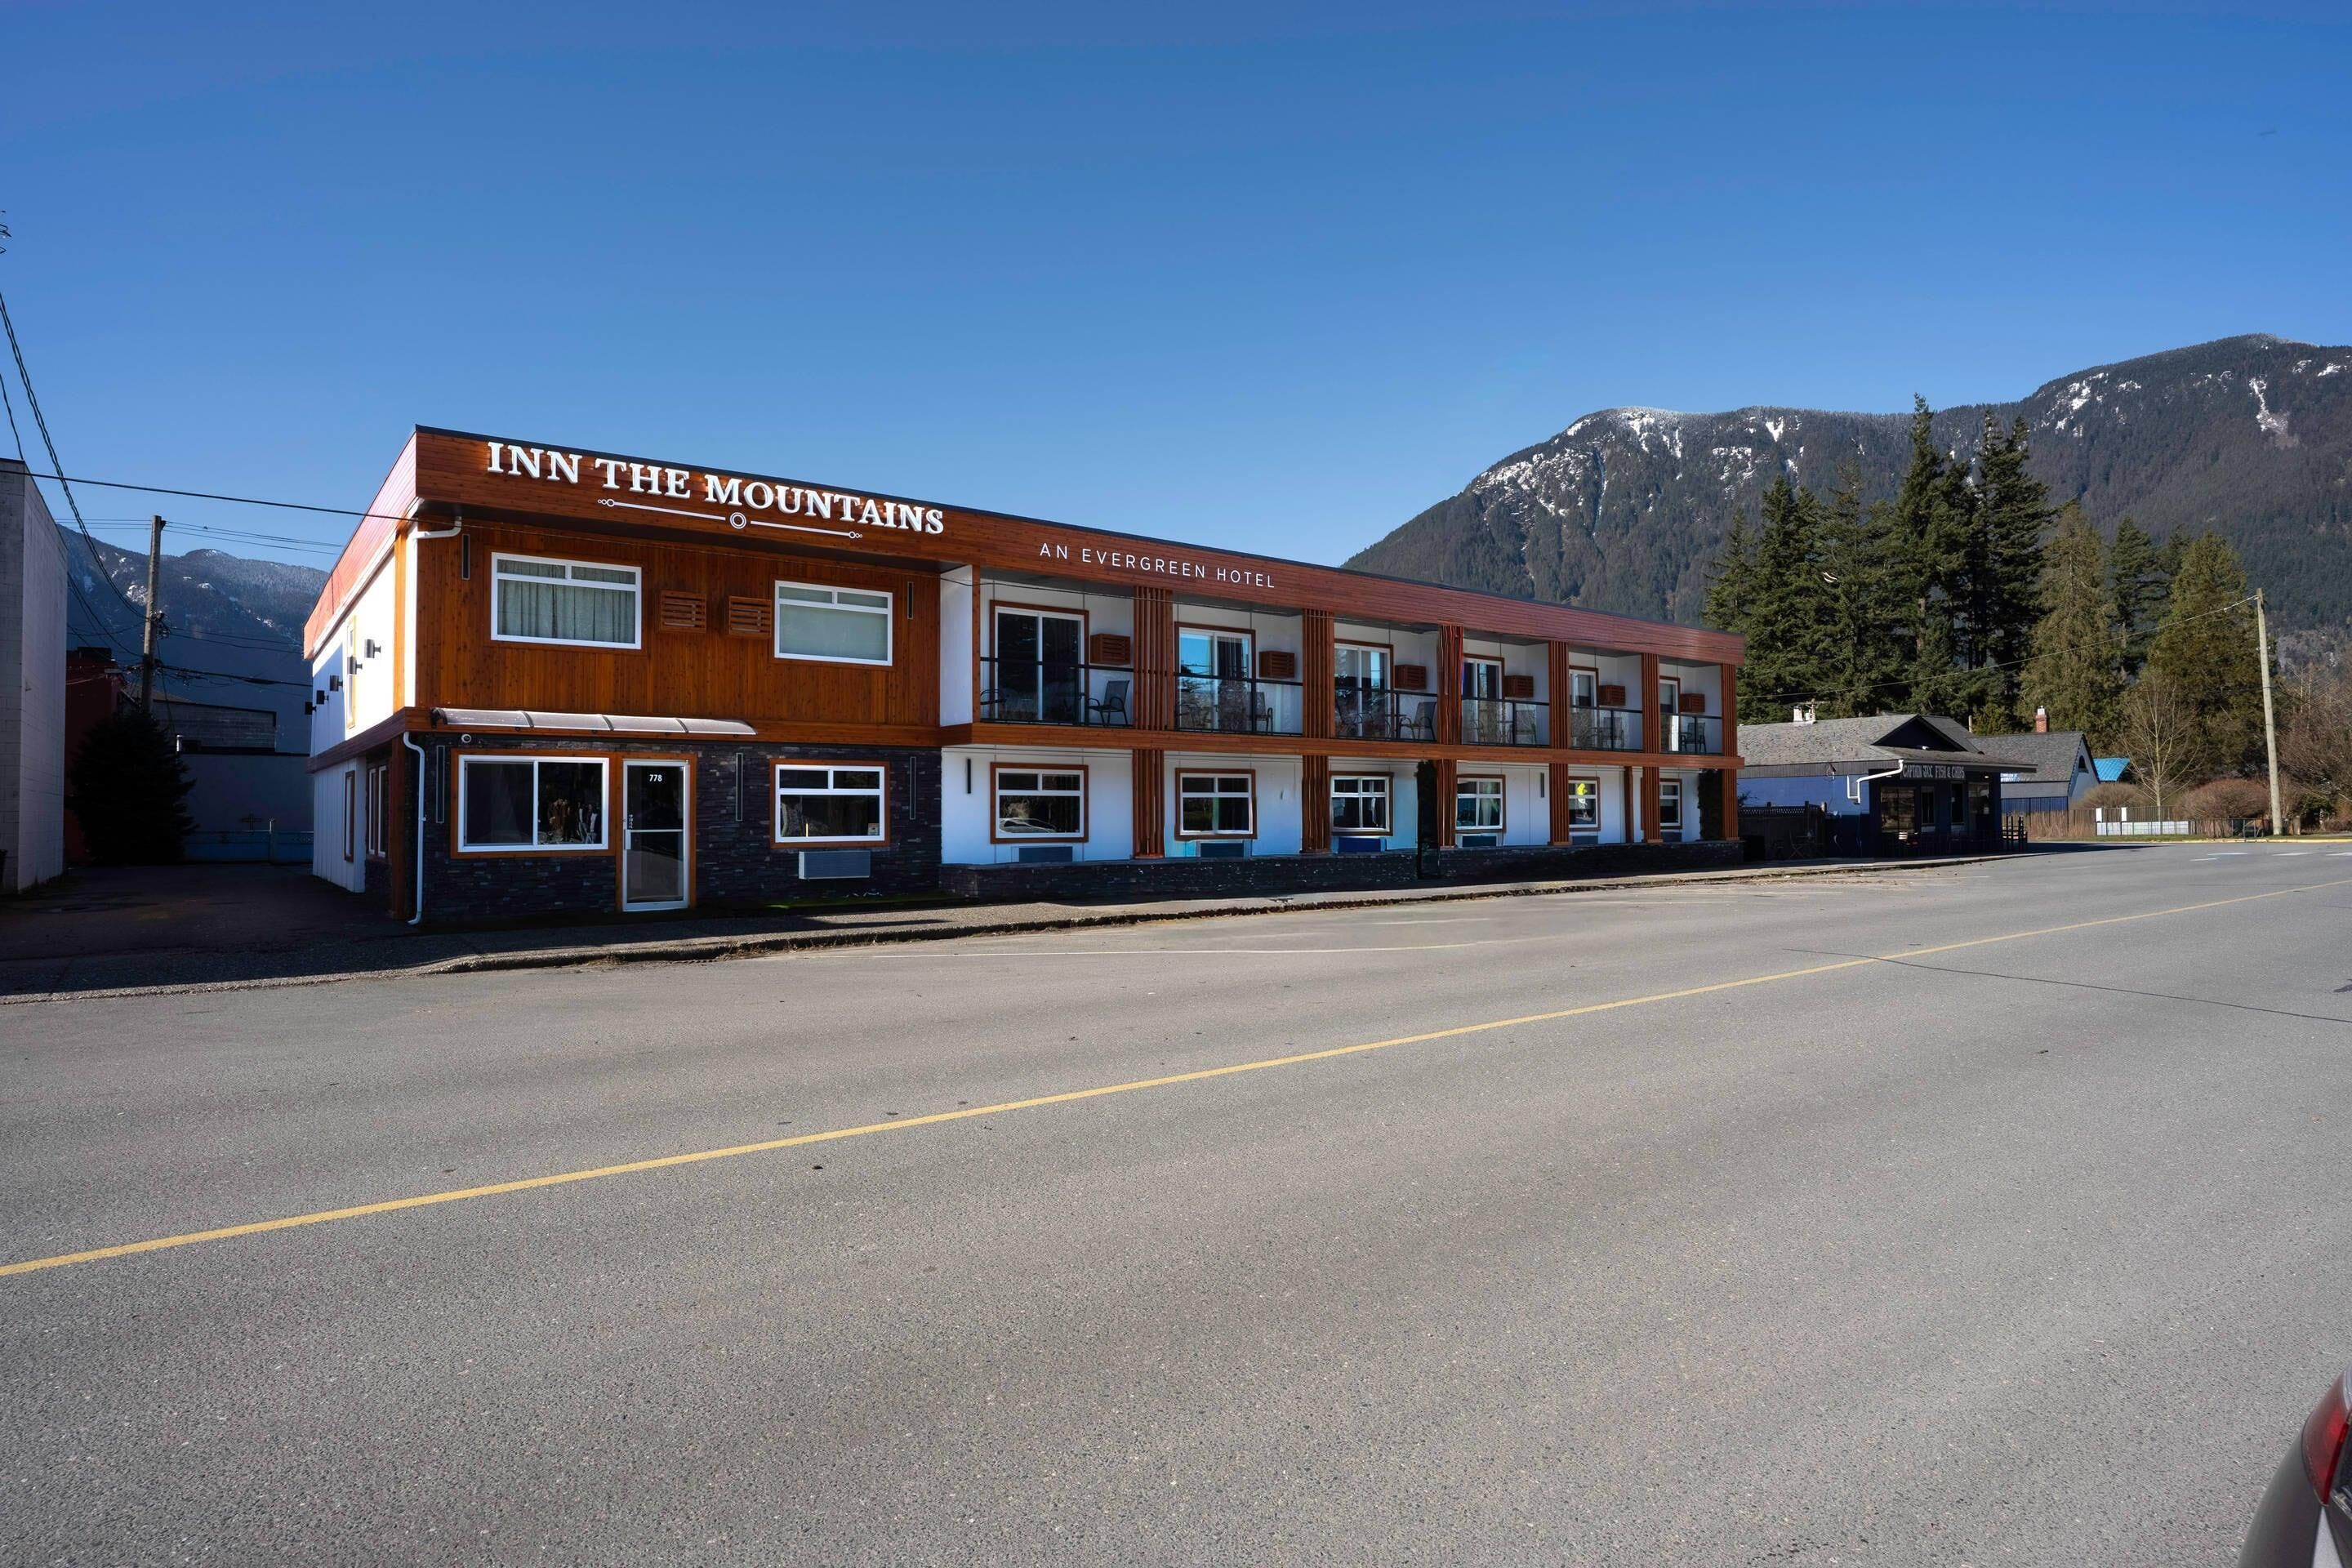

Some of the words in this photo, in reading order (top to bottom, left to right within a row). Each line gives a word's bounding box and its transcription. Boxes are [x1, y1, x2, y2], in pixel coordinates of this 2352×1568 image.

[488, 442, 582, 483] INN
[595, 458, 691, 499] THE
[705, 474, 944, 534] MOUNTAINS
[1040, 542, 1067, 559] AN
[1082, 548, 1205, 579] EVERGREEN
[1217, 568, 1275, 589] HOTEL
[649, 773, 662, 782] 778
